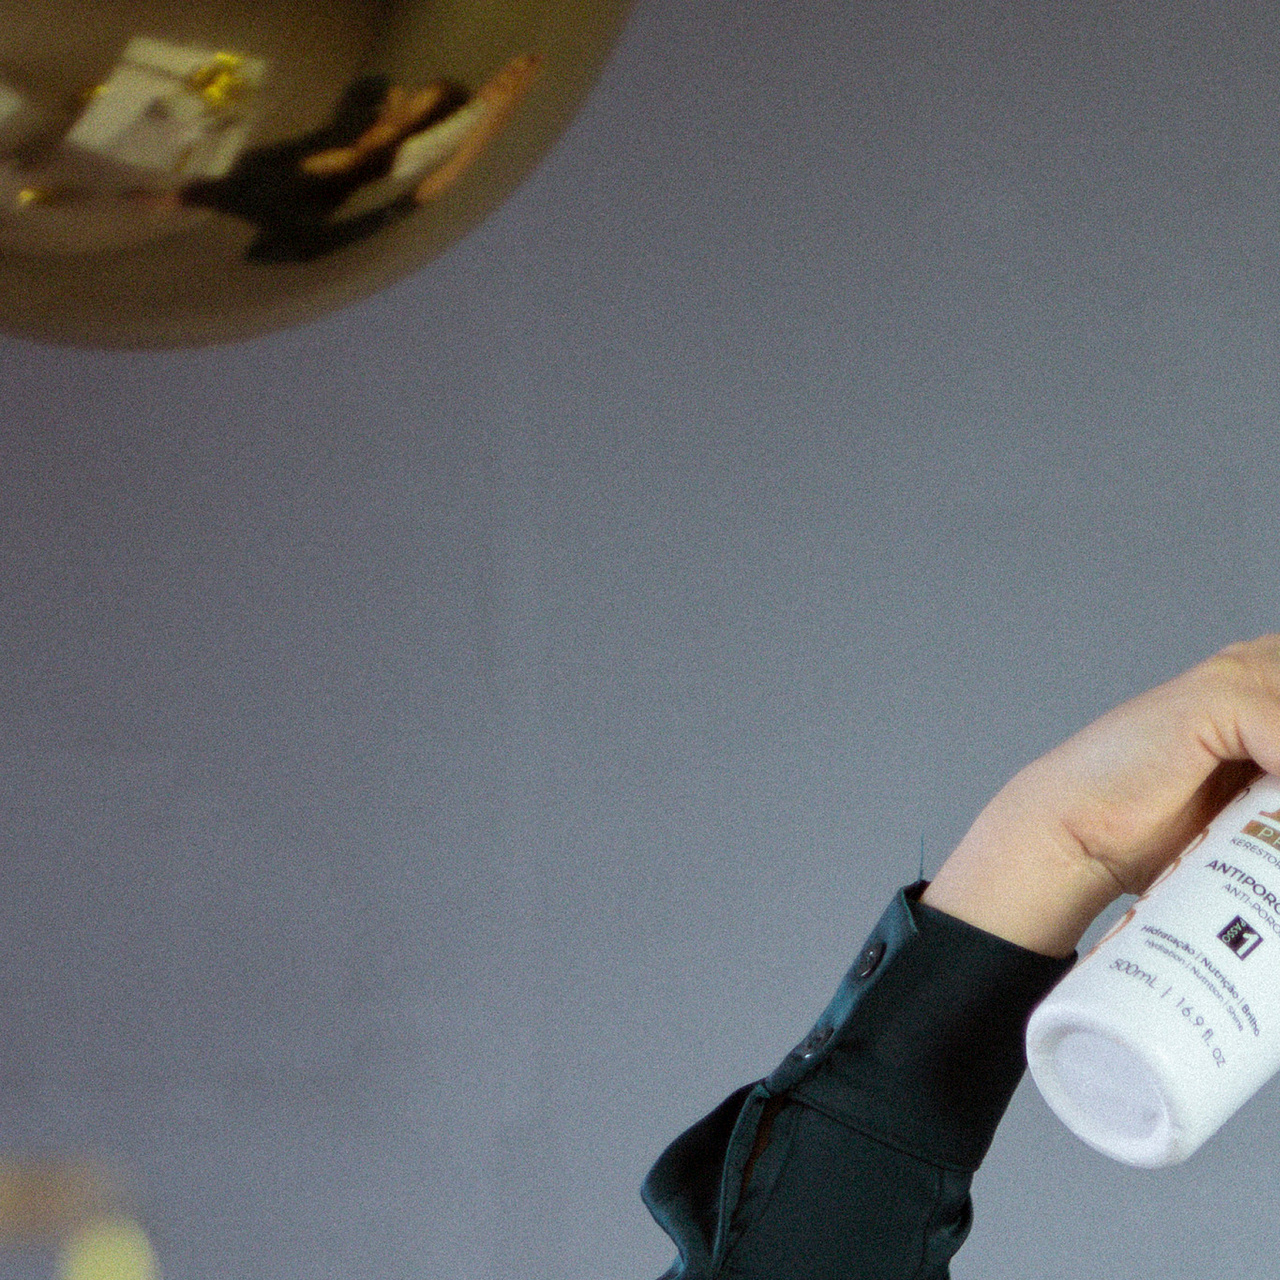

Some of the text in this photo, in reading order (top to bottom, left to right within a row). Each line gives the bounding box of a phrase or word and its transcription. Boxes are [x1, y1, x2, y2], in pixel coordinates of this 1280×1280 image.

[1109, 958, 1158, 988] 500mL
[1141, 925, 1195, 955] Hidratação
[1200, 957, 1239, 999] Nutrição
[1242, 1003, 1260, 1036] Brilho
